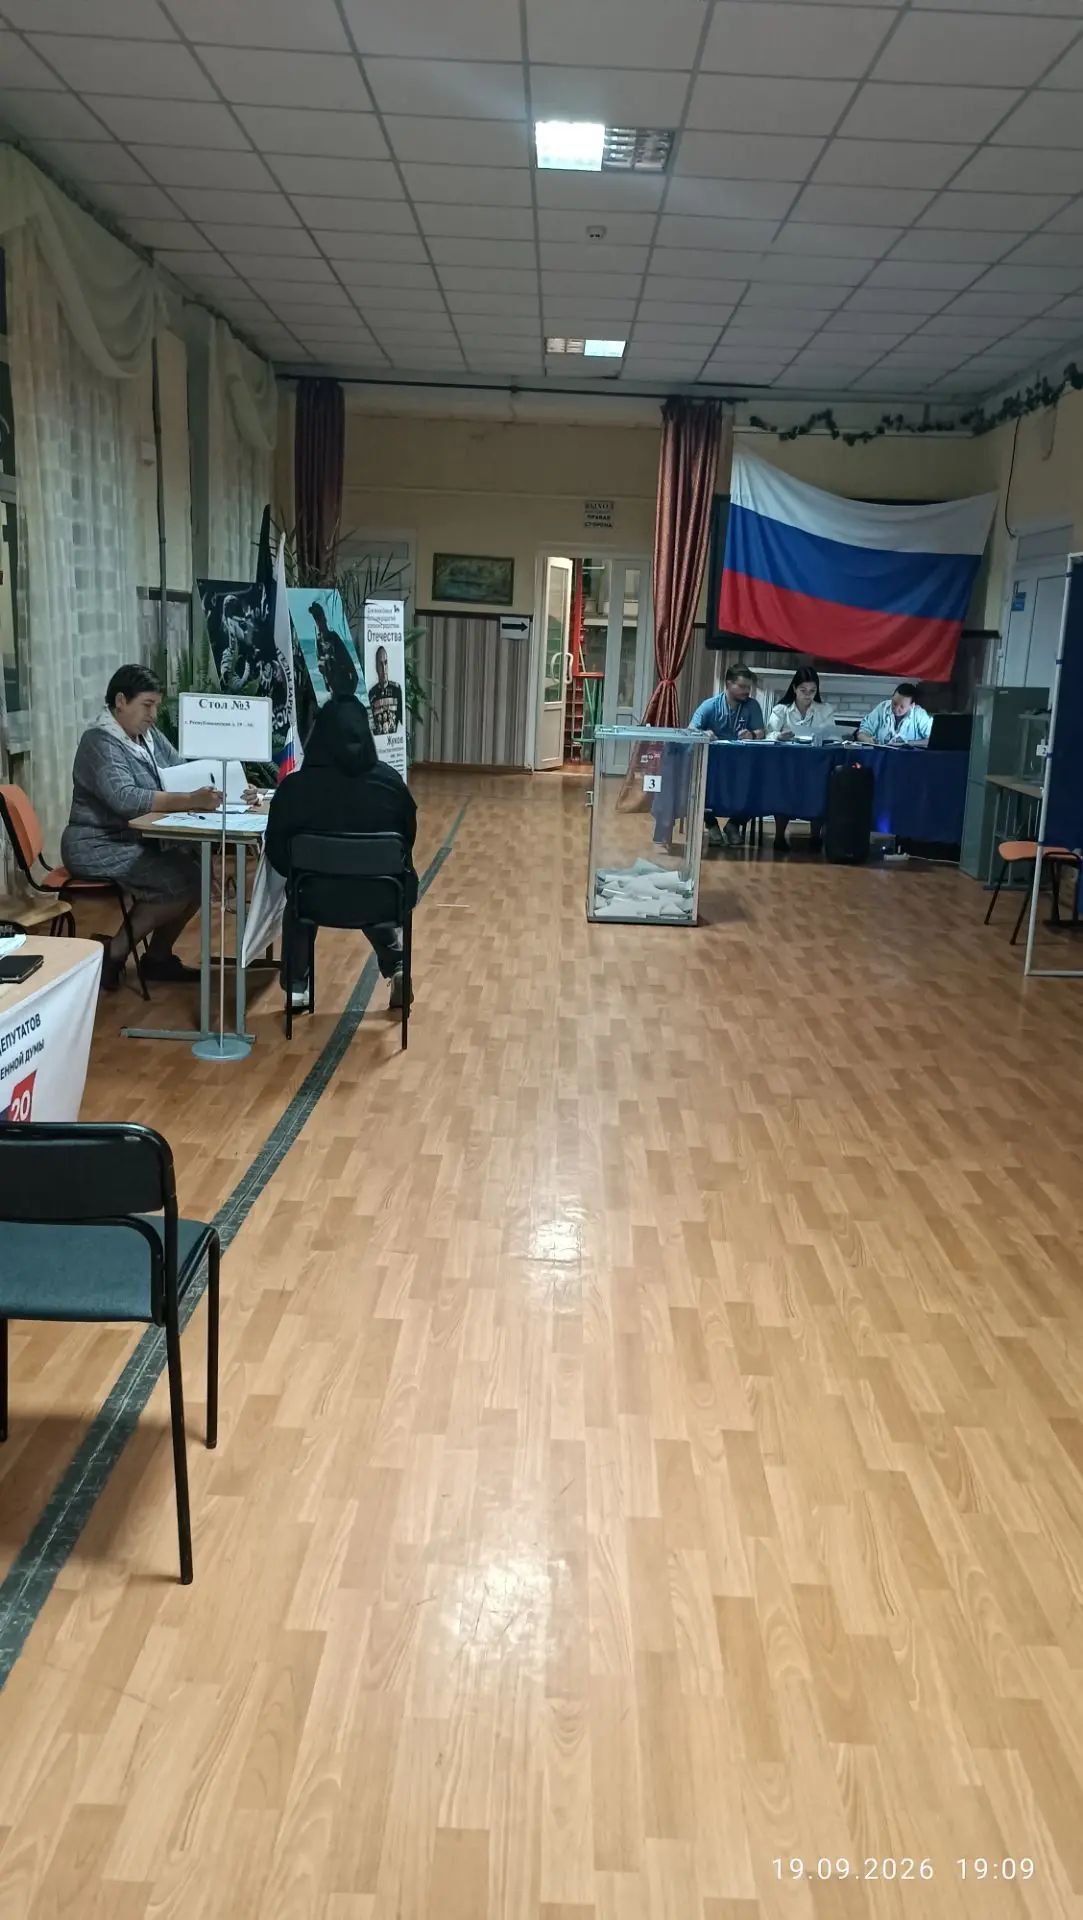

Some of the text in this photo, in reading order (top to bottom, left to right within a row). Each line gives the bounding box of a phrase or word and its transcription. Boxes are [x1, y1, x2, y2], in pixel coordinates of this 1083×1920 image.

[367, 629, 402, 642] Отечества
[198, 698, 251, 711] Стол №3
[648, 778, 656, 789] 3
[0, 1013, 41, 1057] ЕПУТАТОВ
[25, 1038, 45, 1064] ДУМЫ
[11, 1089, 31, 1122] 20
